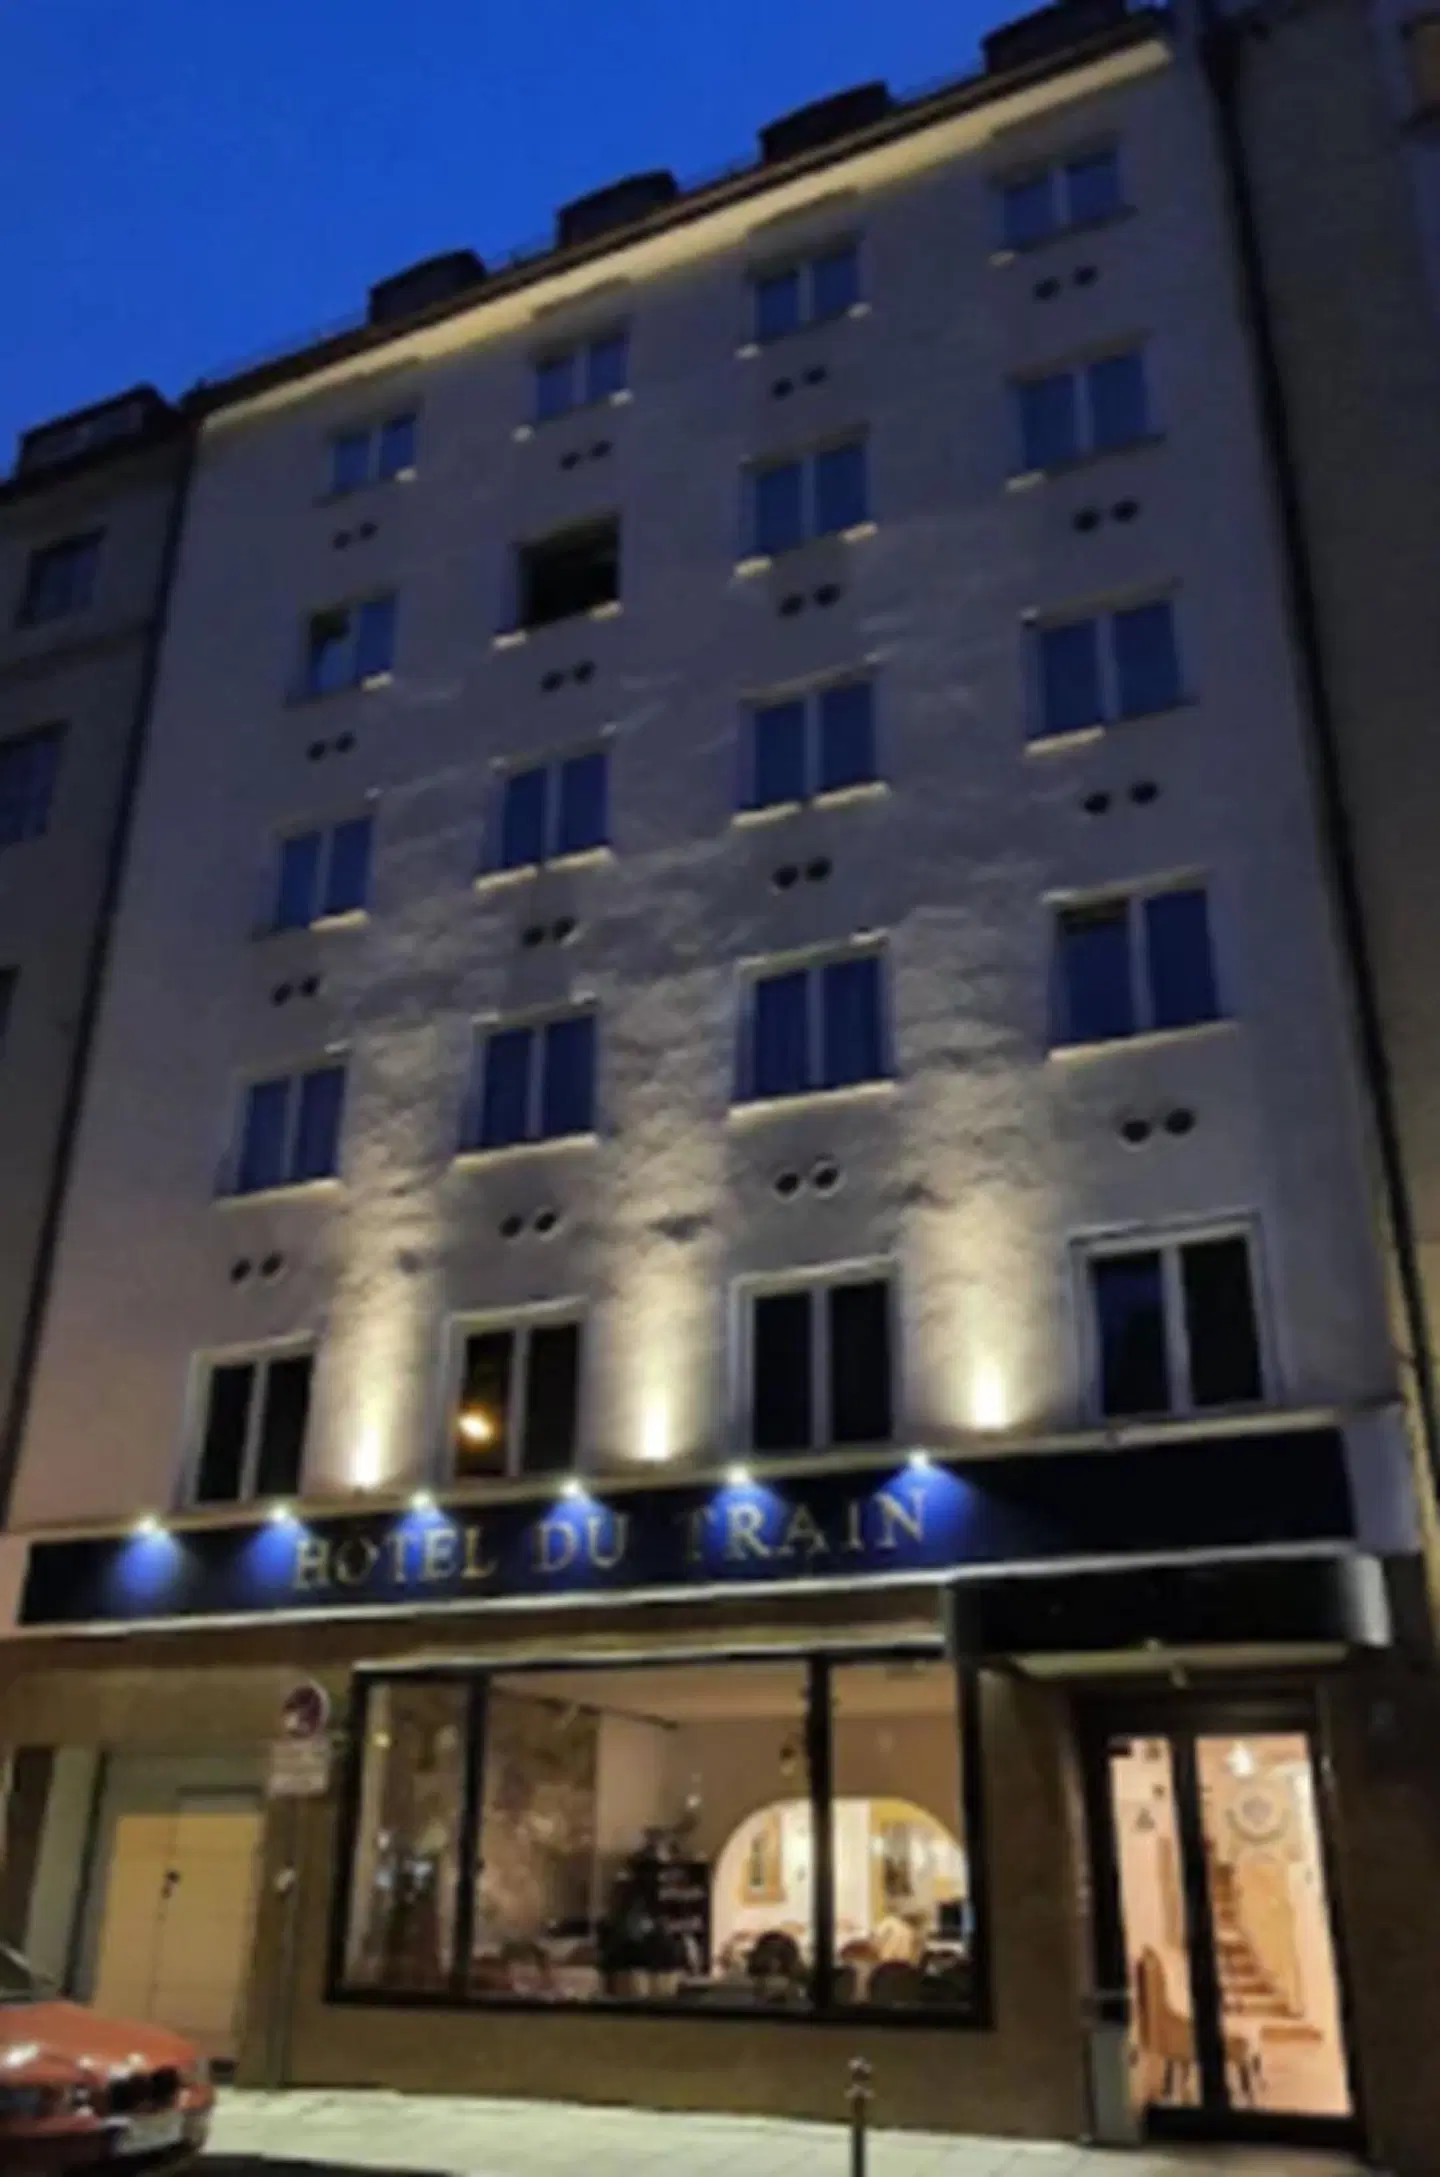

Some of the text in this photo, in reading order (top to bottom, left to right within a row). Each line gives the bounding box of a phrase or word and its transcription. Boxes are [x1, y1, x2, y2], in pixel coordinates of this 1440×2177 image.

[293, 1489, 927, 1589] HOTEL DU TRAIN
